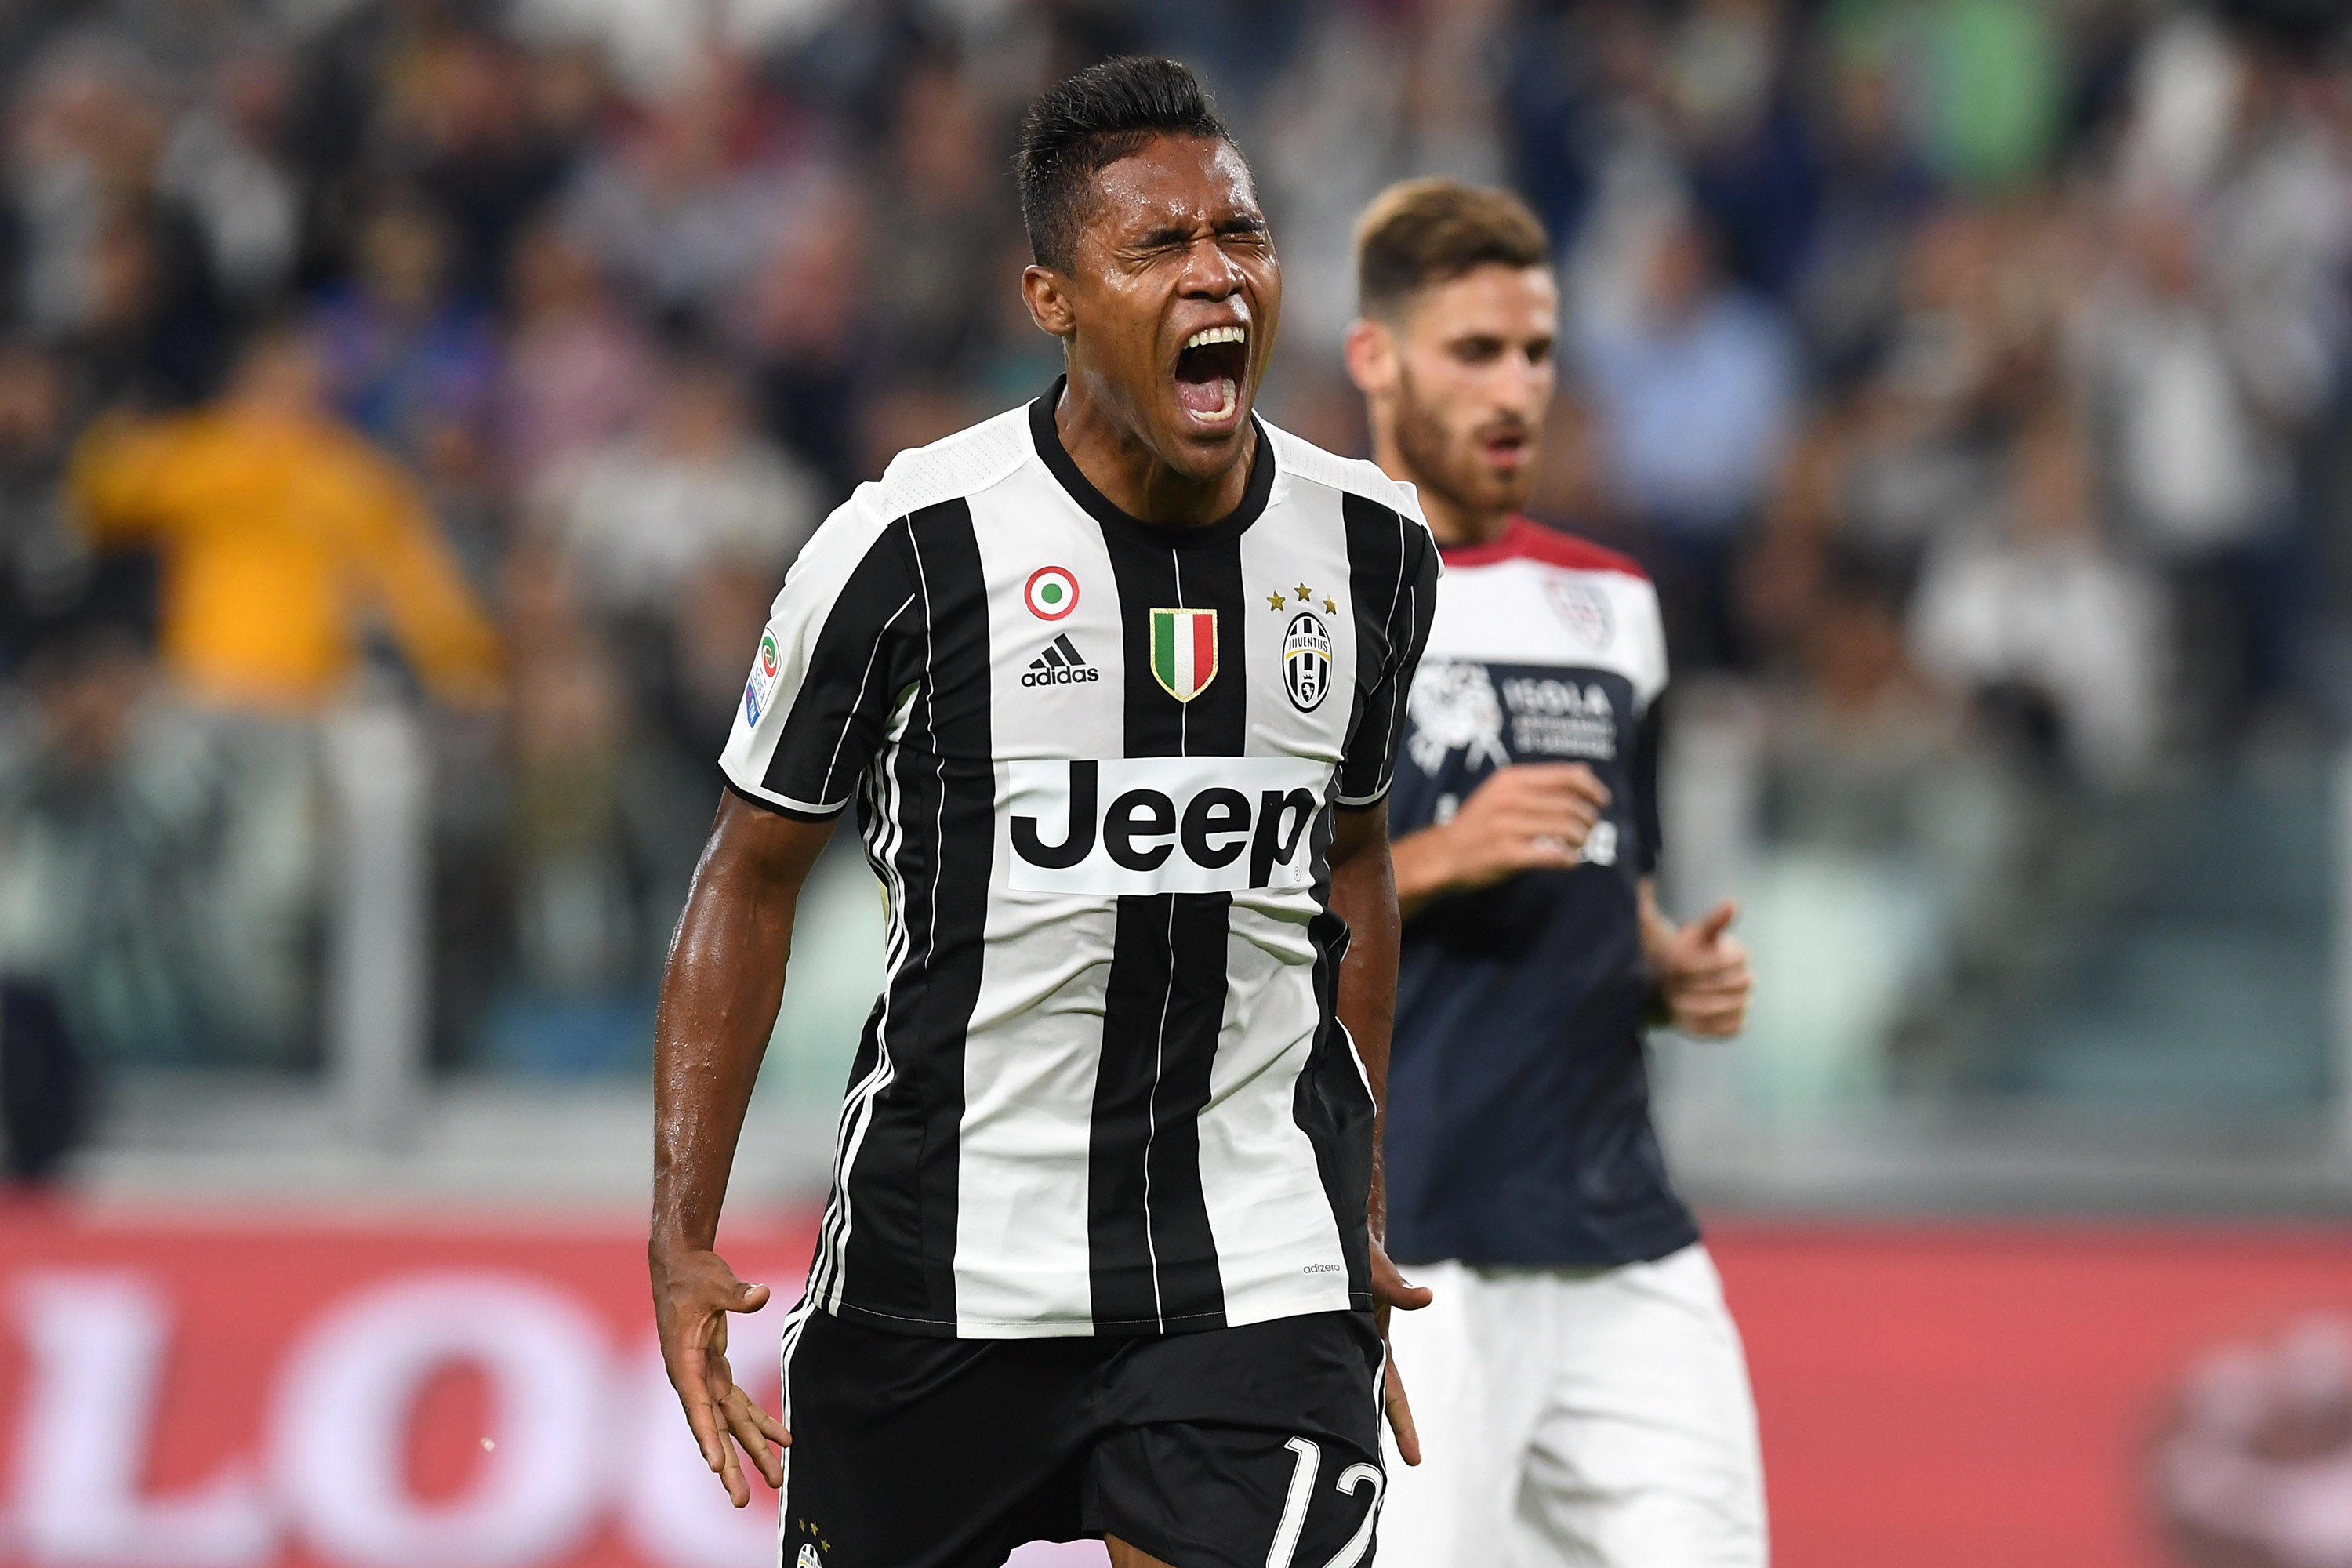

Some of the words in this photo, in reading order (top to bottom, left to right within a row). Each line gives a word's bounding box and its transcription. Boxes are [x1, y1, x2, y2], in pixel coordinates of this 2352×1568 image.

[1288, 636, 1328, 652] JUVENTUS
[1021, 666, 1099, 687] adidas
[1010, 759, 1316, 889] Jeep
[1303, 1263, 1341, 1274] adizero
[1265, 1436, 1385, 1568] 12
